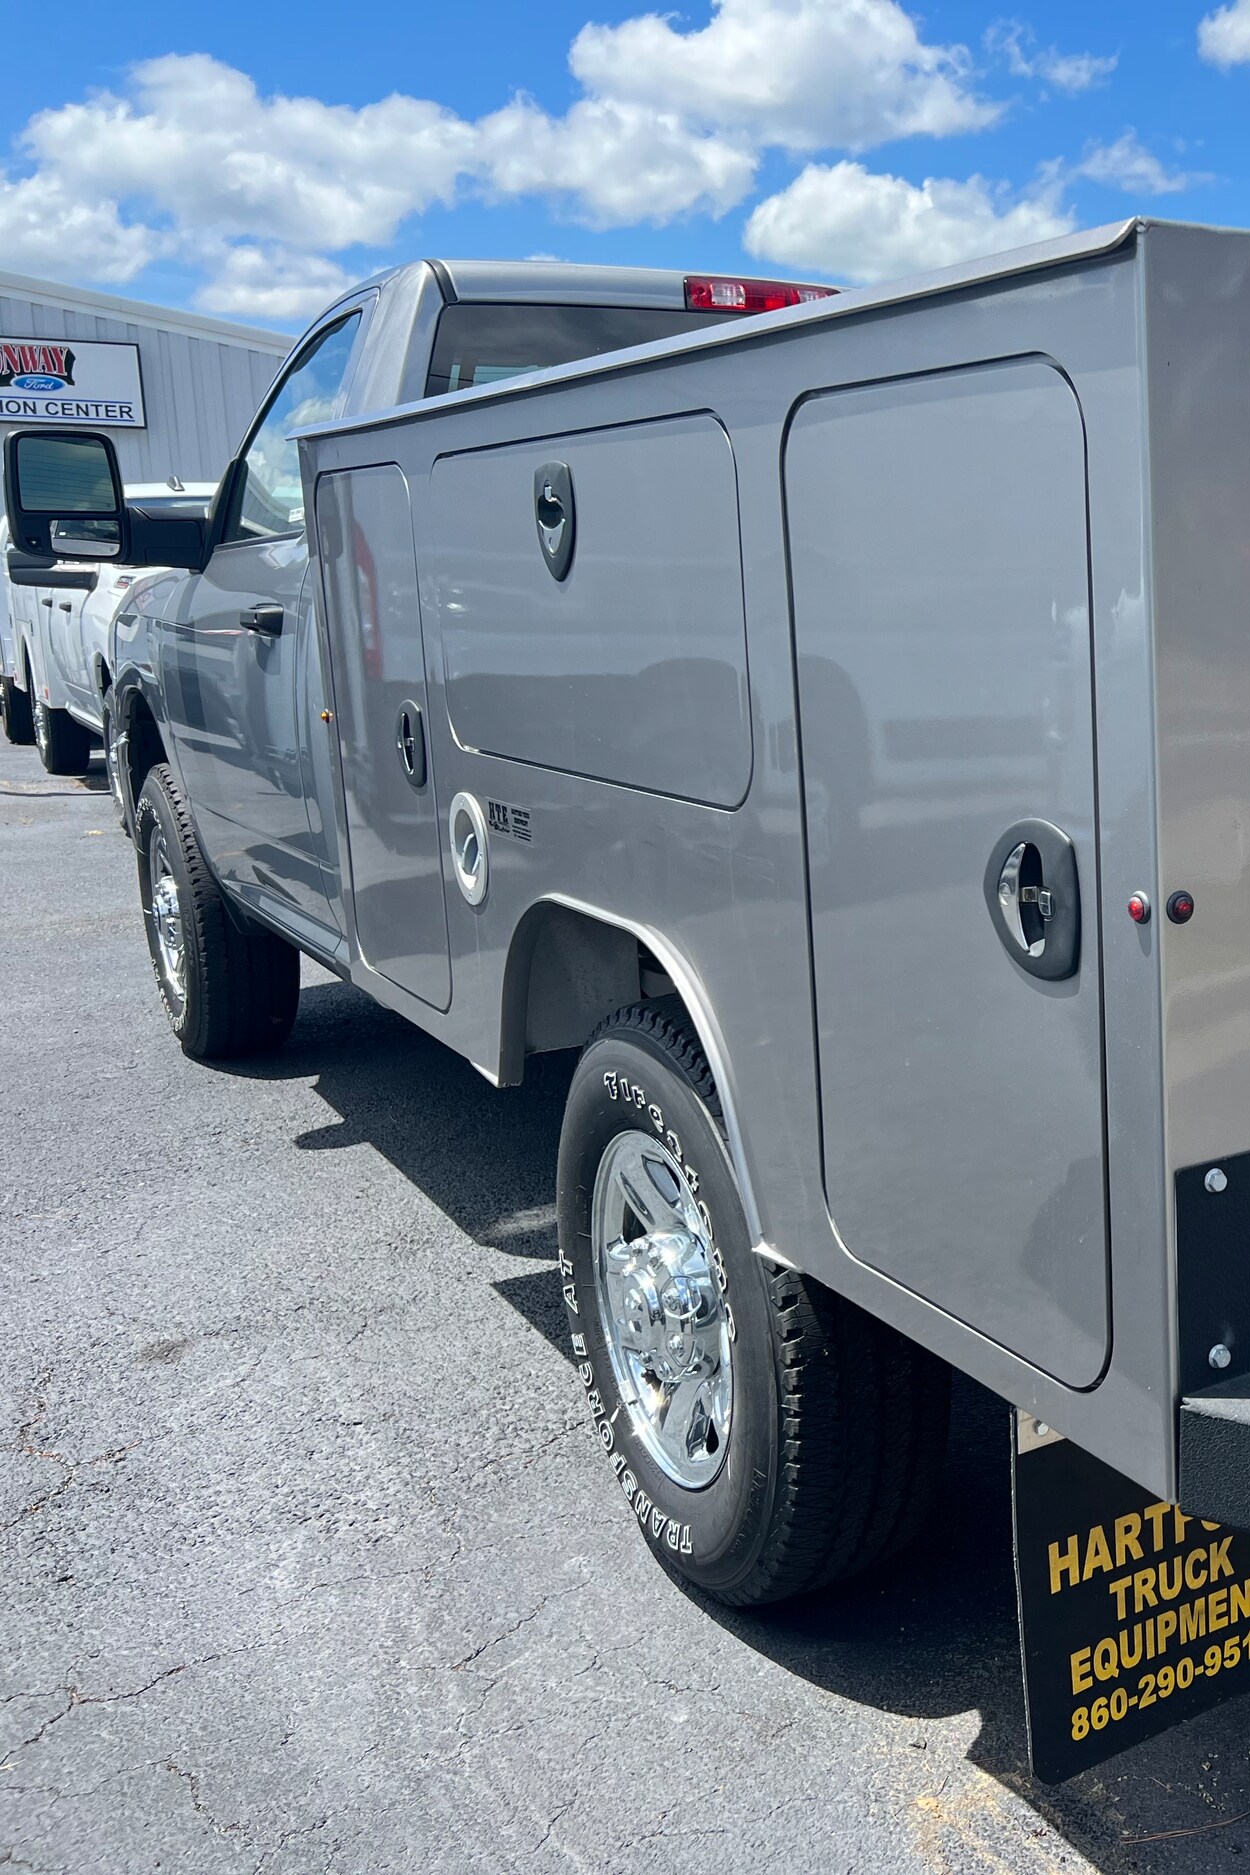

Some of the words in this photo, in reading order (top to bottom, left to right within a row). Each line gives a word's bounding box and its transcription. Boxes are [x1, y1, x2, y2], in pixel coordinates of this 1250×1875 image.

[0, 344, 68, 376] NWAY
[23, 378, 54, 390] Ford
[45, 402, 134, 419] CENTER
[488, 801, 508, 823] HTE
[558, 1248, 579, 1315] AT
[571, 1332, 694, 1555] TRANSFORCE
[1048, 1502, 1222, 1594] HARTF
[1109, 1535, 1235, 1621] TRUCK
